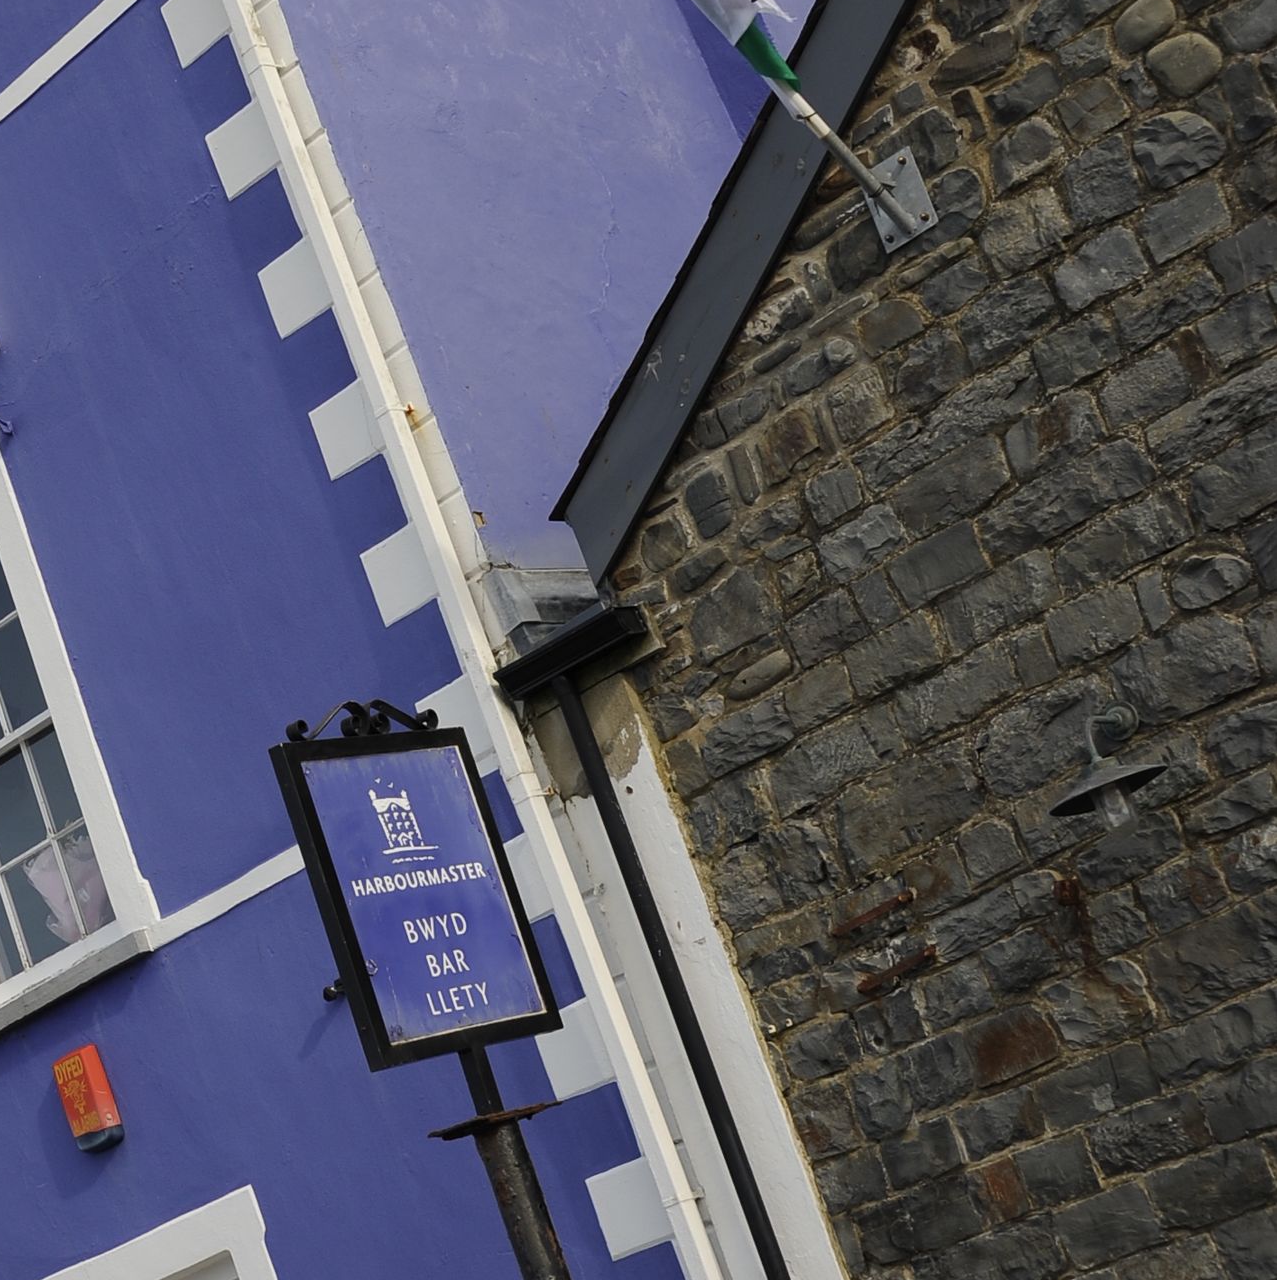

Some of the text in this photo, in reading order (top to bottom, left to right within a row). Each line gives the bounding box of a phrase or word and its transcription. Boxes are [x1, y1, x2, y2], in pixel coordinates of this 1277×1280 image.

[351, 862, 487, 897] HARBOURMASTER
[403, 912, 468, 944] BWYD
[425, 949, 471, 978] BAR
[426, 981, 490, 1017] LLETY
[53, 1055, 84, 1085] DYFED
